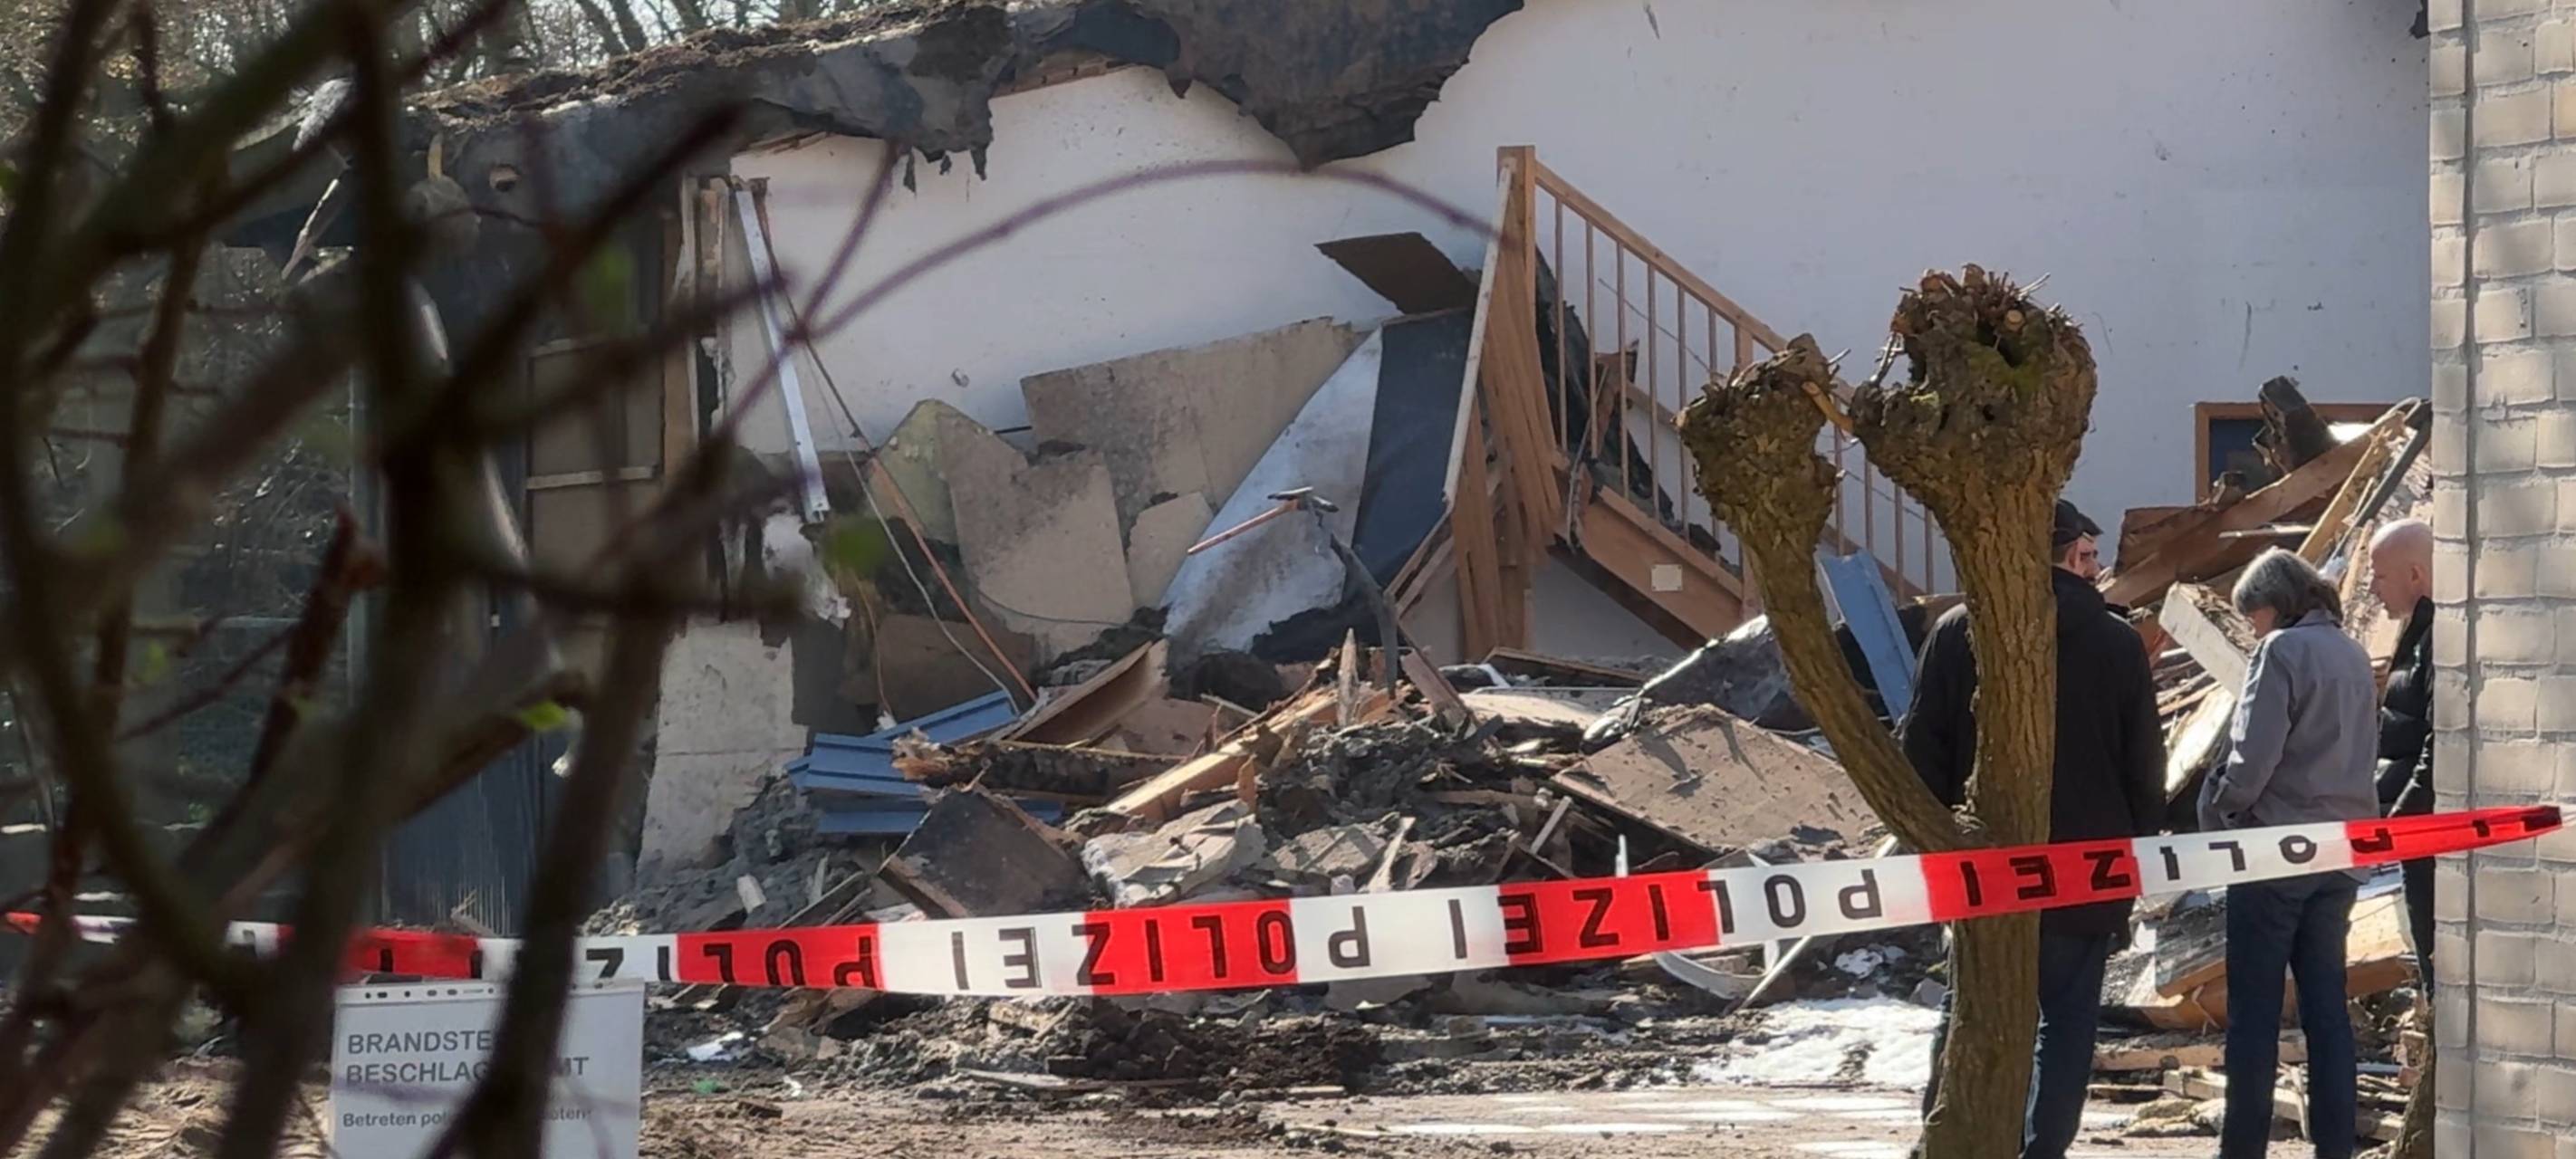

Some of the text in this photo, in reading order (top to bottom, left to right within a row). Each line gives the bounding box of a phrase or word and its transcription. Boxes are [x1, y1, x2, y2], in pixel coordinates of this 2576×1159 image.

[1447, 867, 1882, 959] POLIZEI
[951, 905, 1371, 989] POLIZEI
[348, 1030, 492, 1055] BRANDSTE
[345, 1056, 590, 1085] BESCHLAGT
[342, 1113, 417, 1127] Betreten
